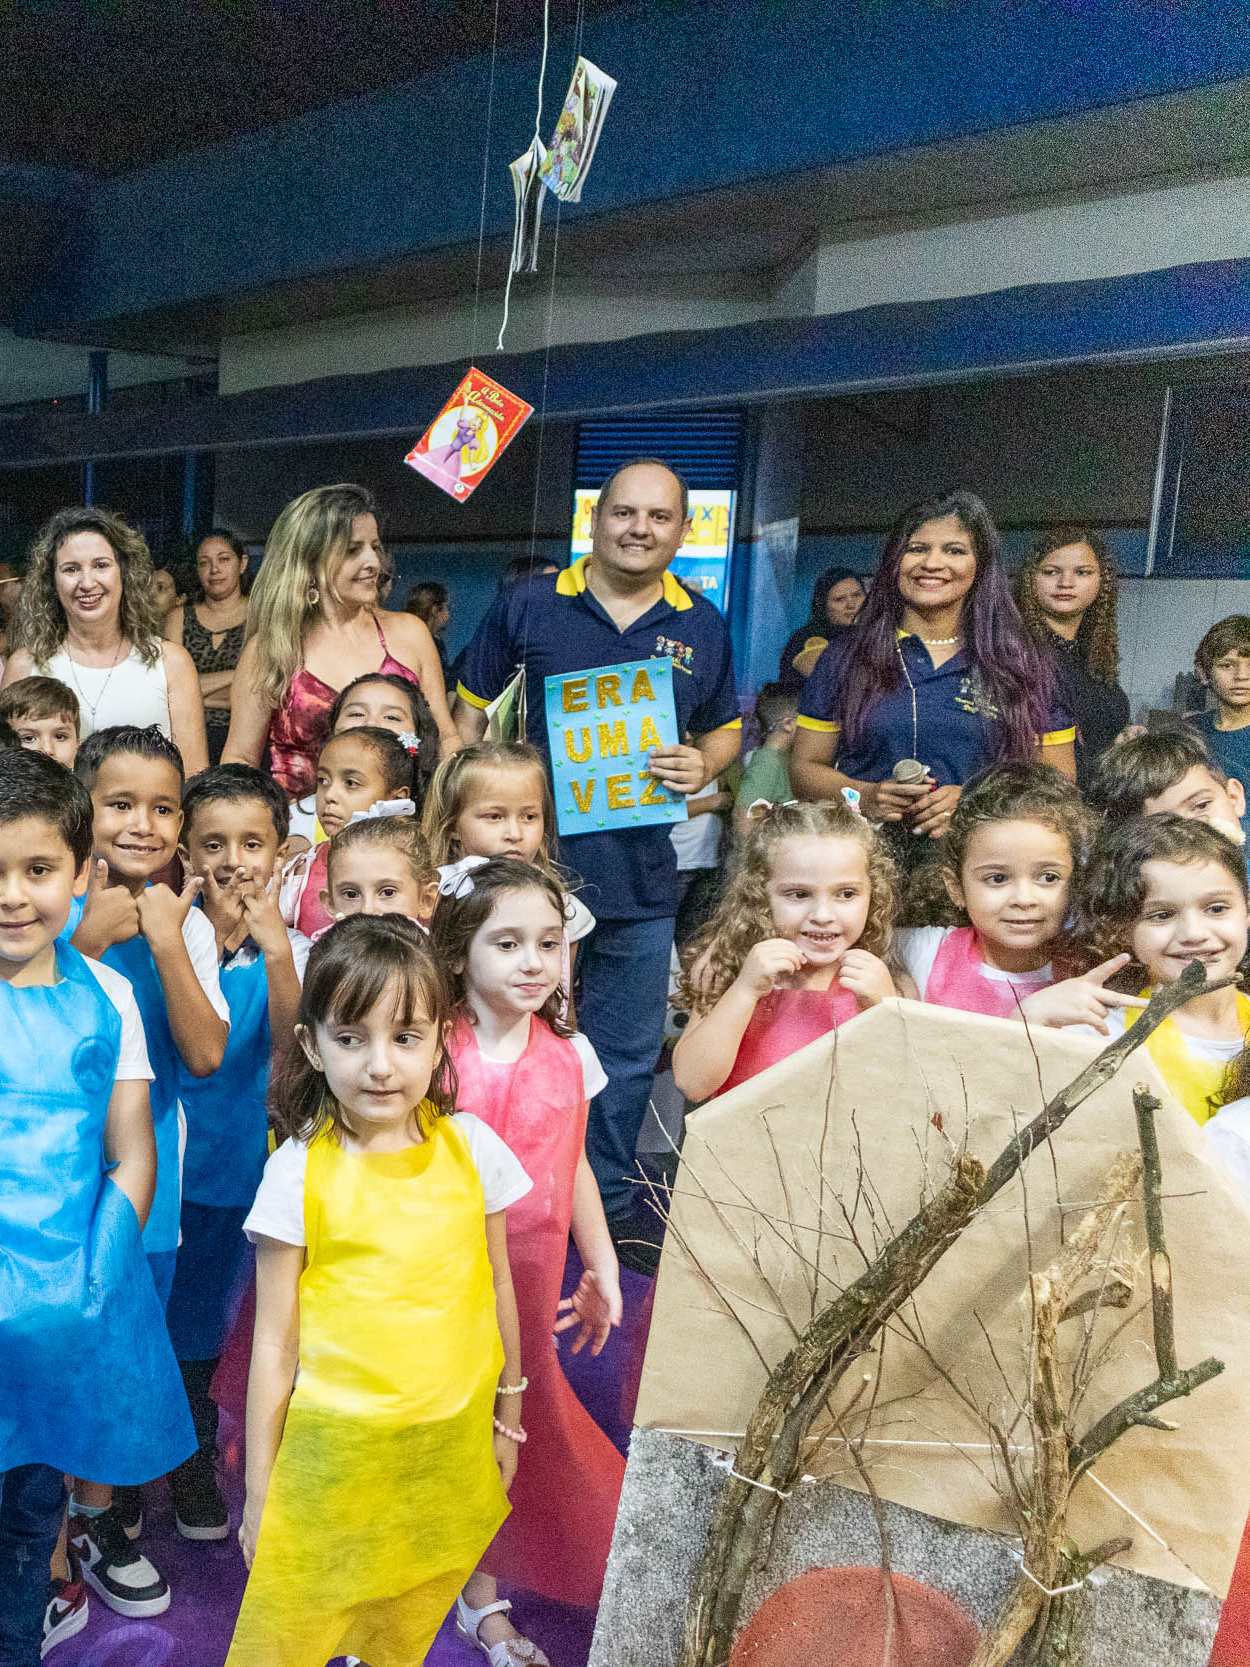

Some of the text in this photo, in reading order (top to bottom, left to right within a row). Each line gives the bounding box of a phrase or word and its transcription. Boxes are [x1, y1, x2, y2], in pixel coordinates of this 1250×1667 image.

[562, 668, 656, 713] ERA
[563, 716, 663, 764] UMA
[570, 770, 667, 814] VEZ
